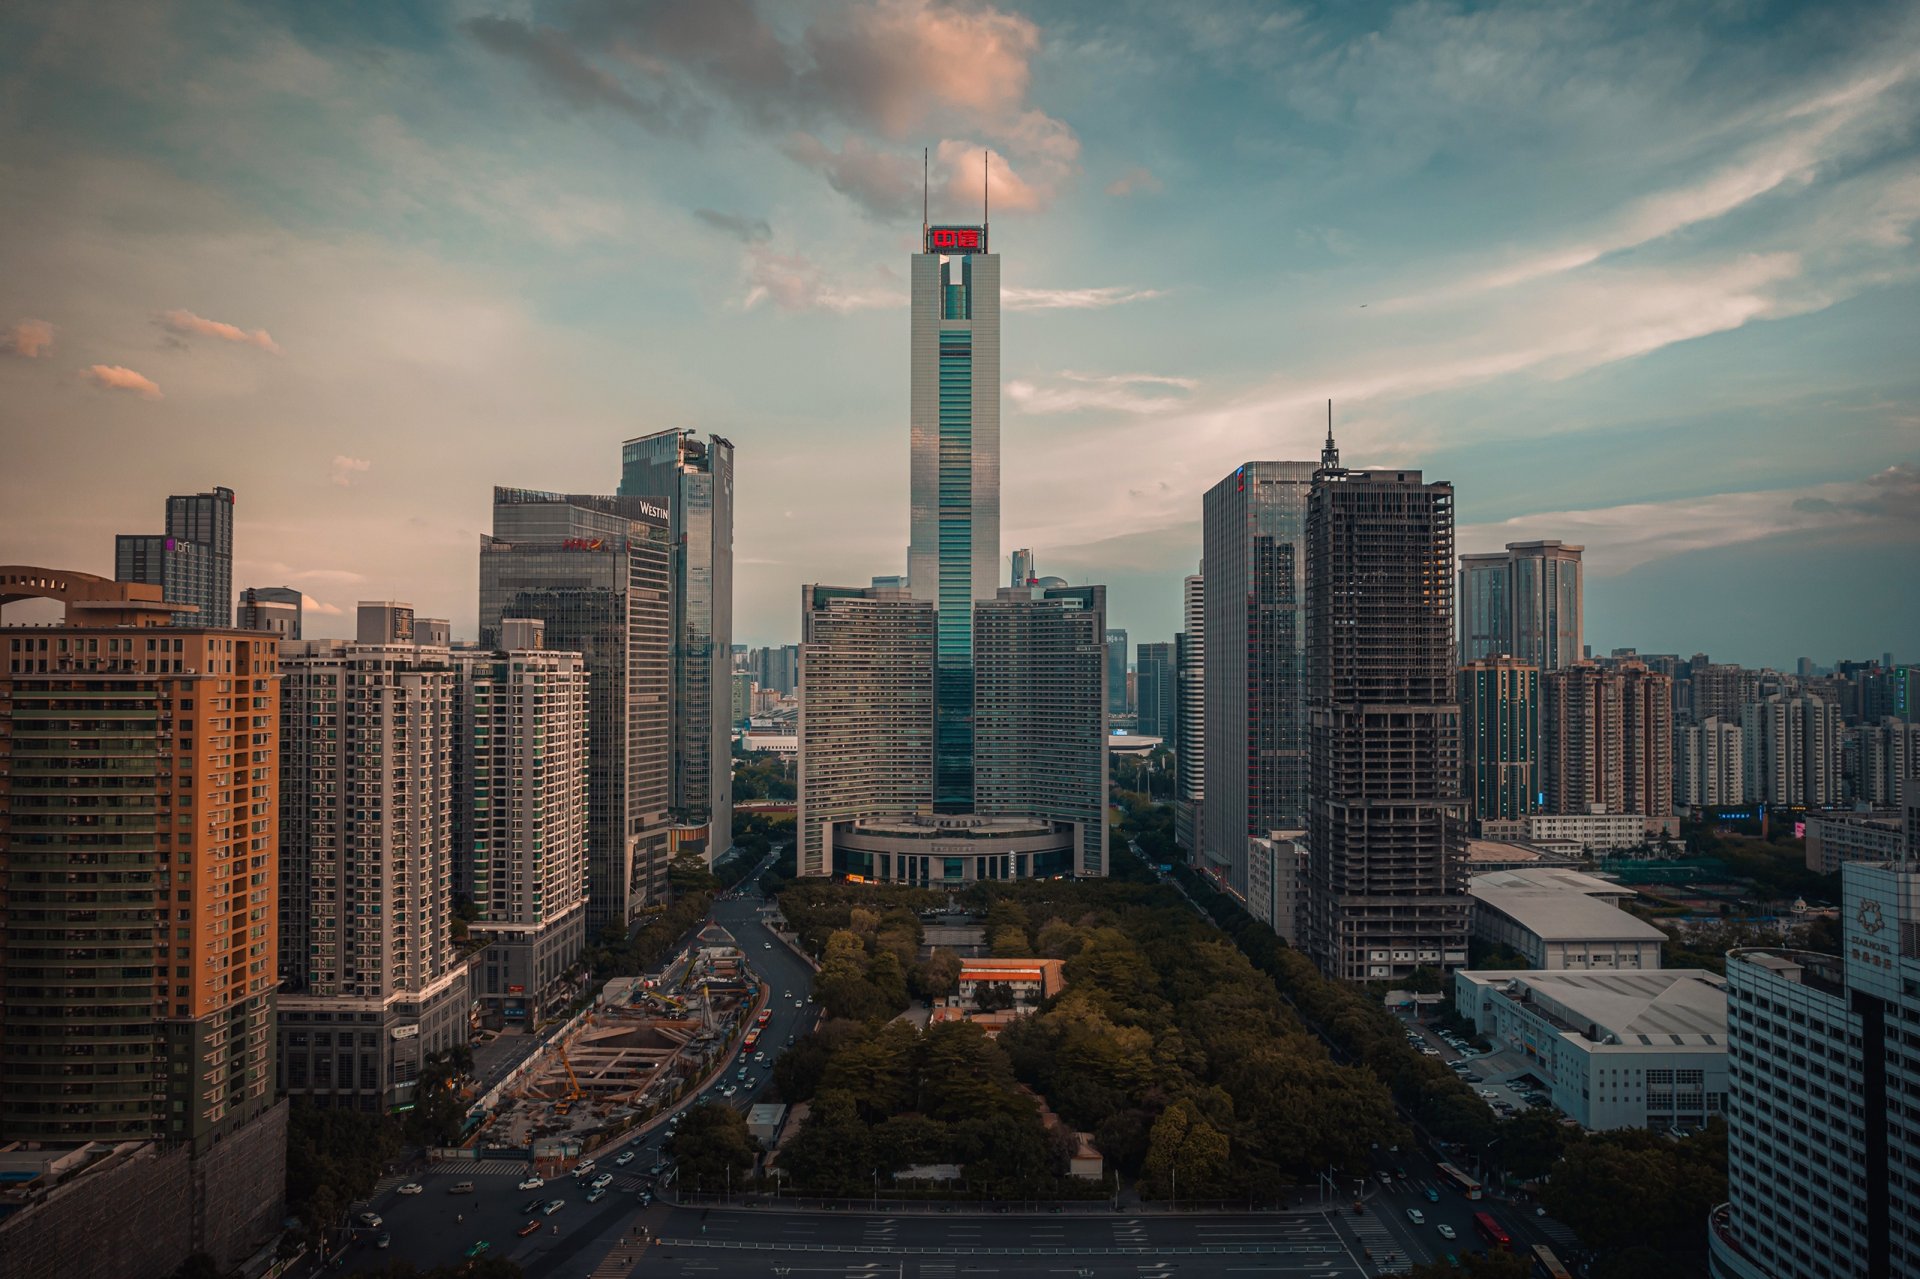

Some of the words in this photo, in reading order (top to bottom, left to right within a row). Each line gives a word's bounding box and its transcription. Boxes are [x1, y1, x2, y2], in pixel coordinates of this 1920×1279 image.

[933, 229, 978, 247] 中信
[639, 501, 669, 520] WESTIN
[166, 537, 190, 553] loft
